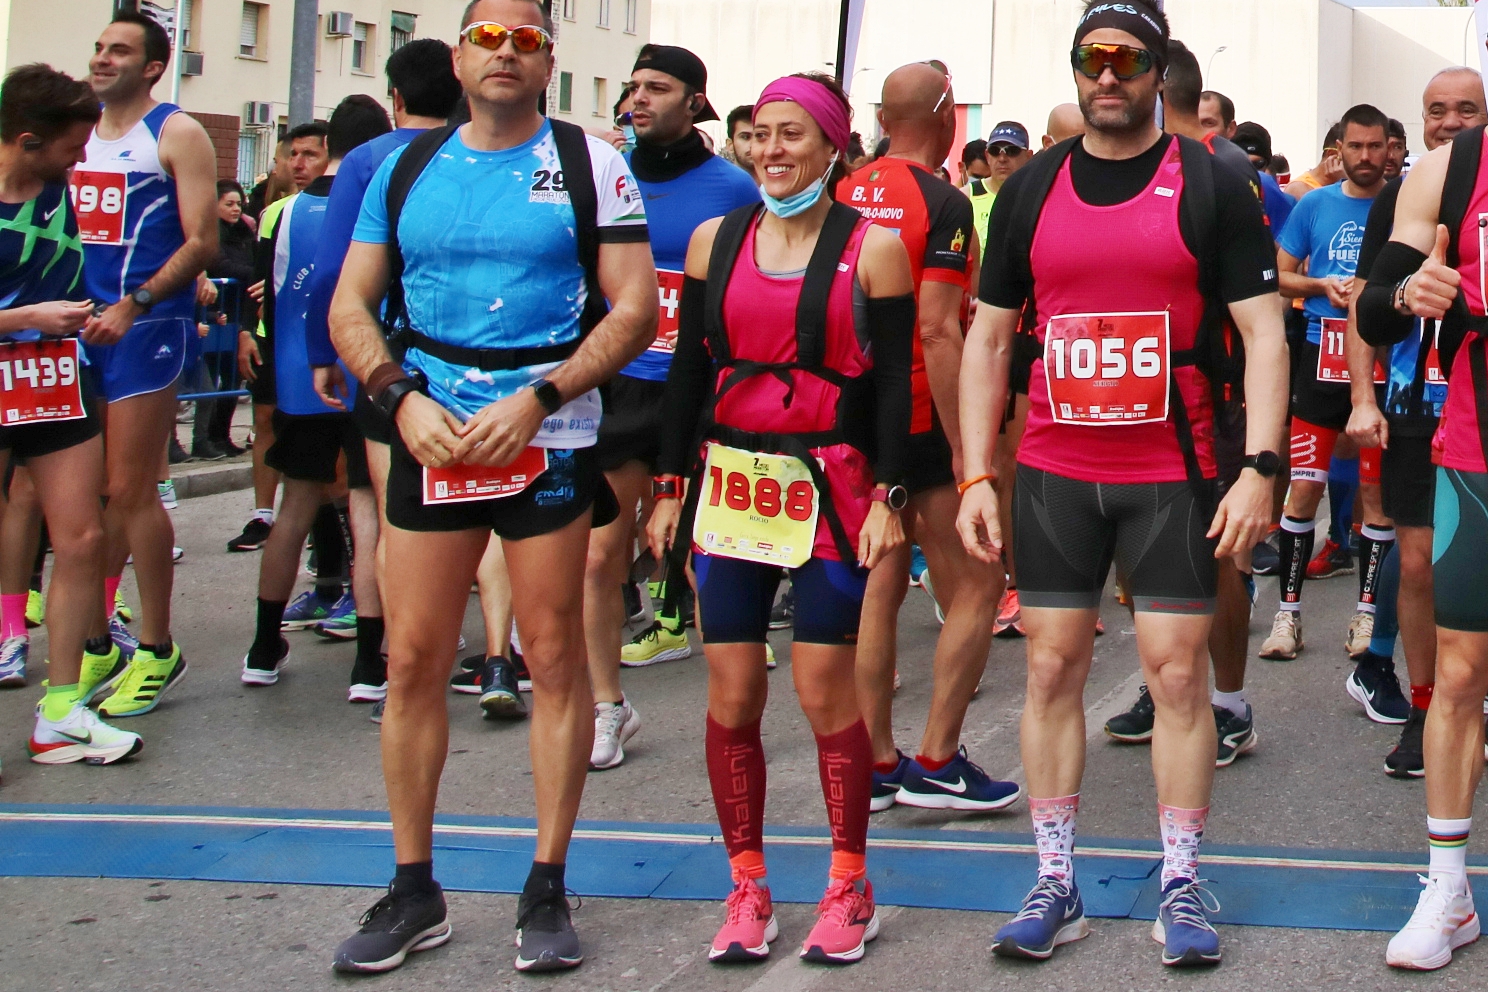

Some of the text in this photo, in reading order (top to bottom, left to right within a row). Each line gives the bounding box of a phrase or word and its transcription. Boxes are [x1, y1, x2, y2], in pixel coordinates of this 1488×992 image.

[851, 186, 885, 203] B. V.
[293, 267, 310, 290] CLUB
[1051, 337, 1161, 379] 1056
[0, 357, 76, 391] 1439
[542, 416, 564, 434] ego
[708, 465, 814, 522] 1888
[749, 514, 769, 524] ROCIO
